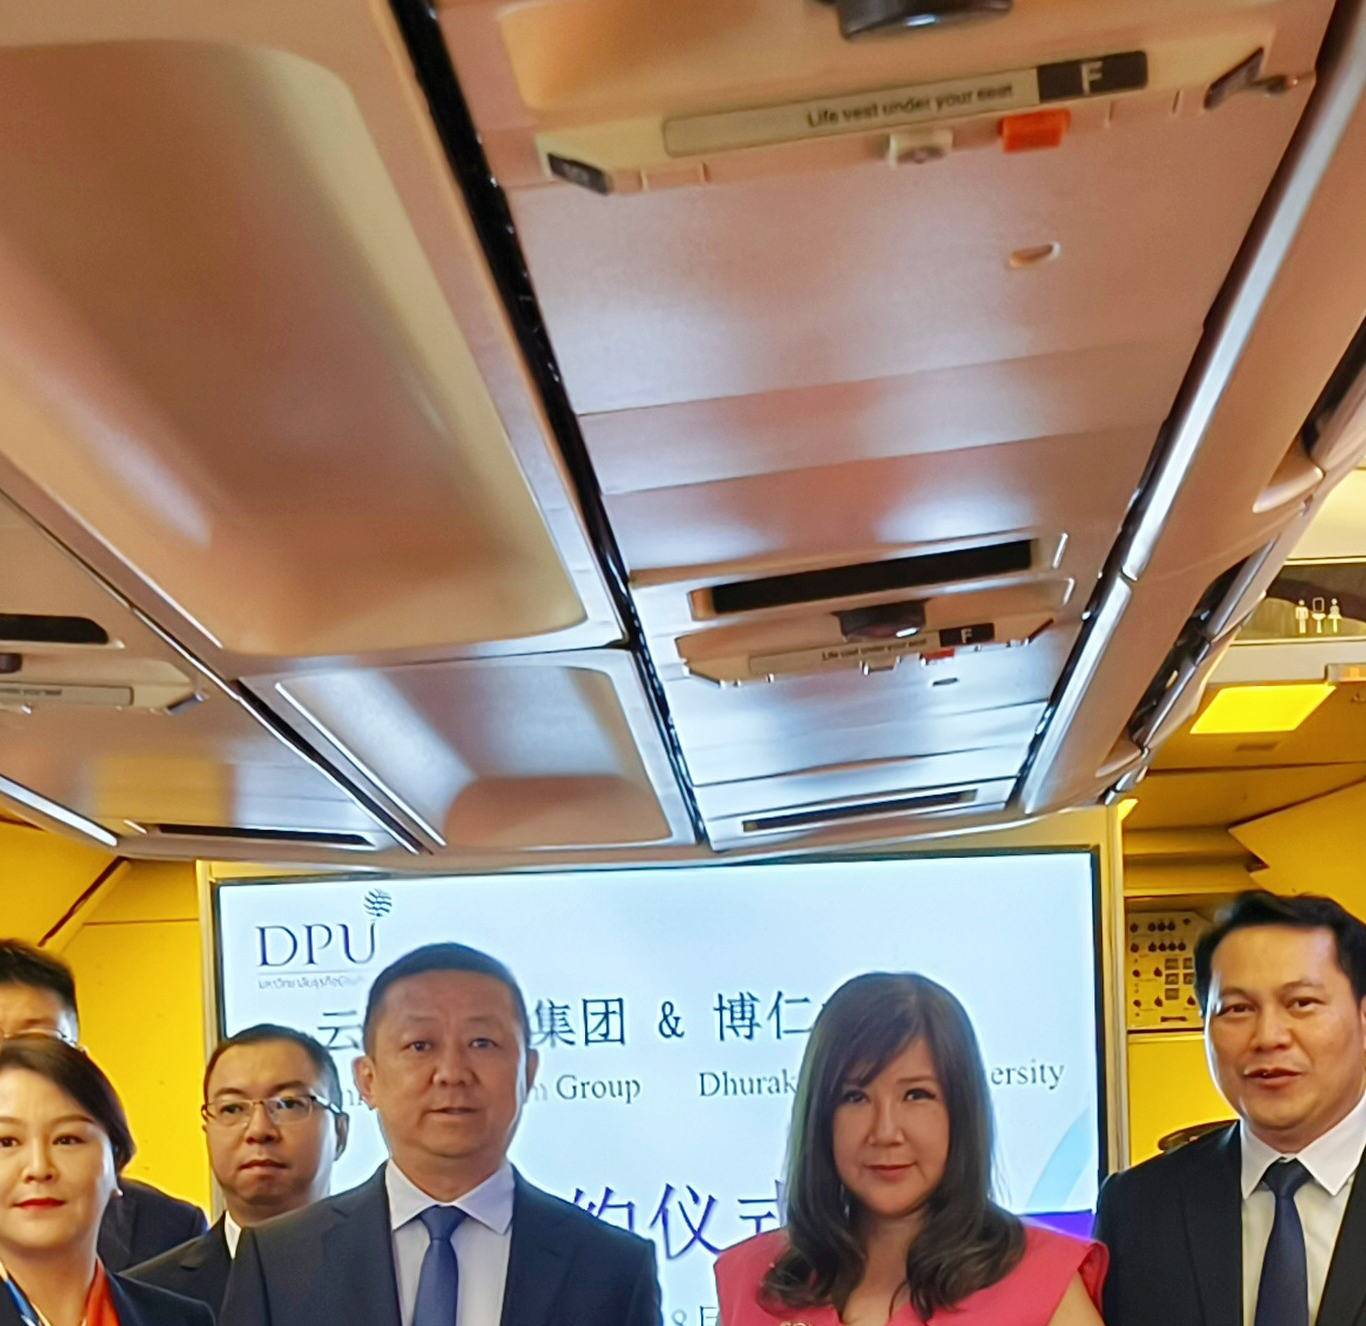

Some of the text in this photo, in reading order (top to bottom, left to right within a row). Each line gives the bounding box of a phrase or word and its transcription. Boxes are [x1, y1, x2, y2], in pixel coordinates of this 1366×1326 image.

[1080, 60, 1104, 95] F
[807, 109, 840, 128] Life
[842, 103, 879, 121] vest
[883, 97, 931, 115] under
[934, 90, 974, 111] your
[961, 628, 973, 644] F
[256, 918, 377, 968] DPU
[657, 1000, 685, 1040] &
[712, 991, 829, 1042] 博仁
[555, 1073, 641, 1104] Group
[698, 1058, 1065, 1098] Dhurak ersity
